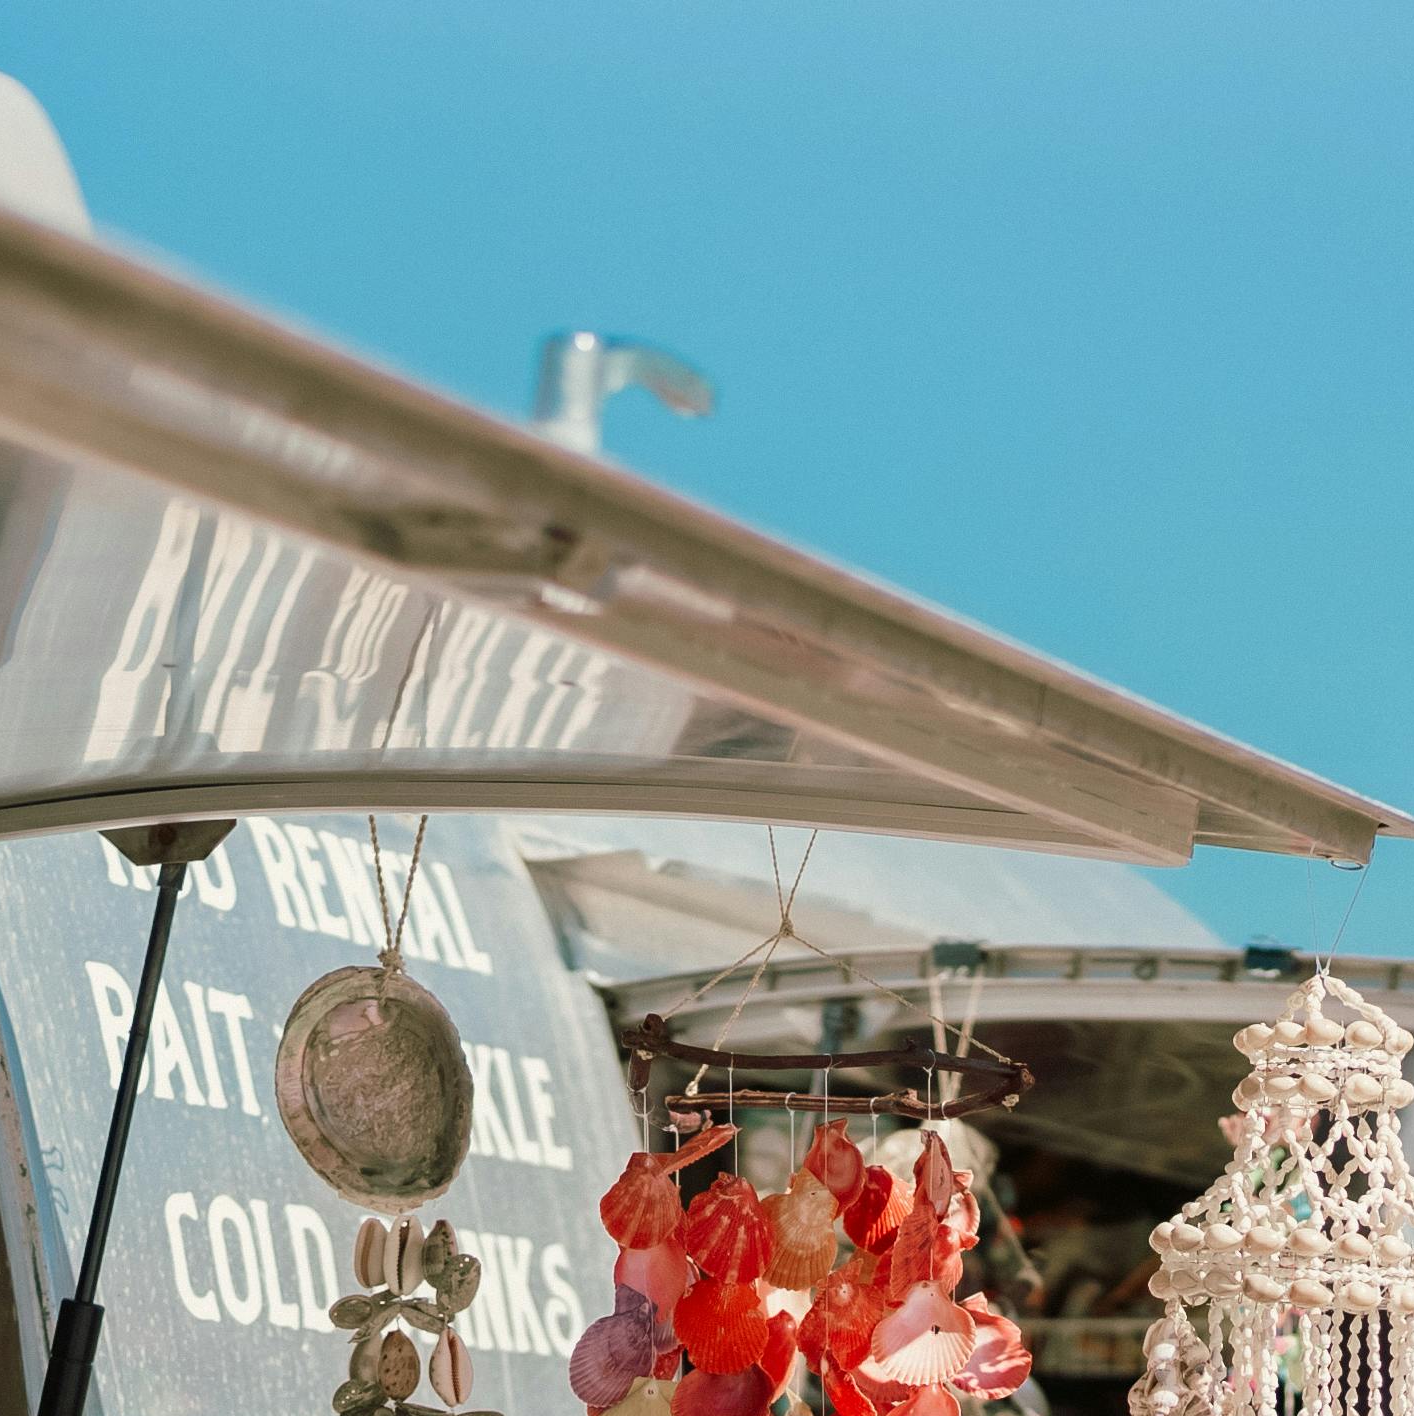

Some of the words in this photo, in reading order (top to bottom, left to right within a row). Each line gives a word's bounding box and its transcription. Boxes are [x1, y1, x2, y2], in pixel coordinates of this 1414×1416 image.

[246, 815, 492, 975] RENTAL
[85, 960, 261, 1117] BAIT
[165, 1192, 339, 1334] COLD
